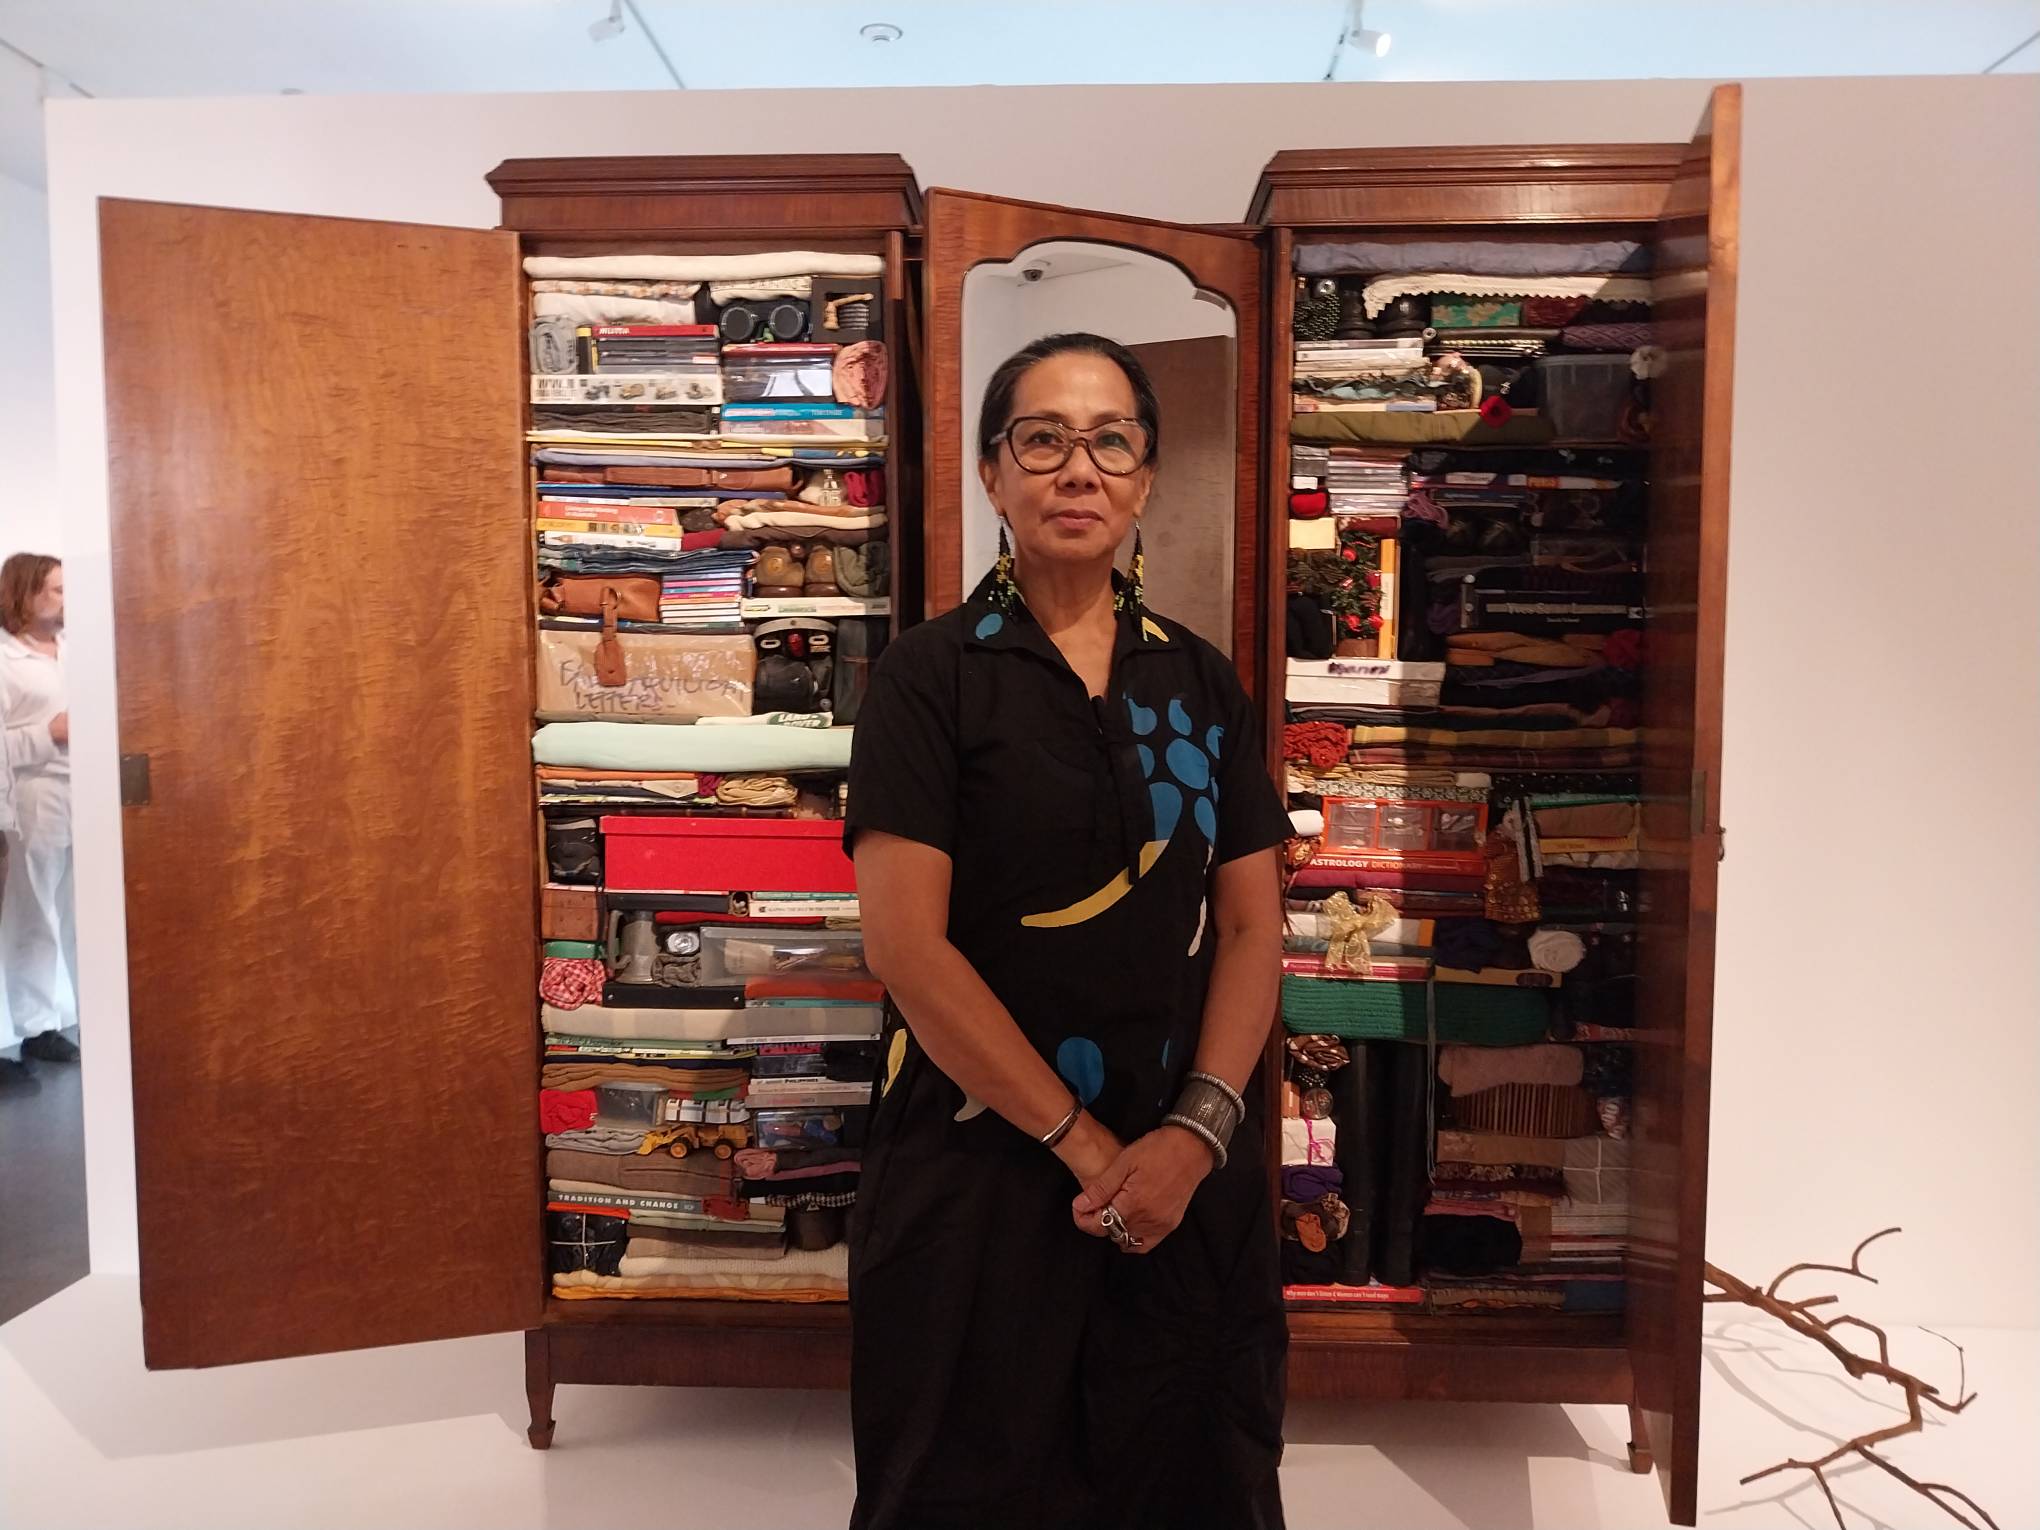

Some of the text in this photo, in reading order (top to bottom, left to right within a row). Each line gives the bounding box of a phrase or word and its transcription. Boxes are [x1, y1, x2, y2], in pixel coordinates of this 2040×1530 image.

[1309, 858, 1370, 868] ASTROLOGY
[558, 1193, 612, 1205] TRADITION
[615, 1197, 636, 1207] AND
[639, 1200, 680, 1210] CHANGE
